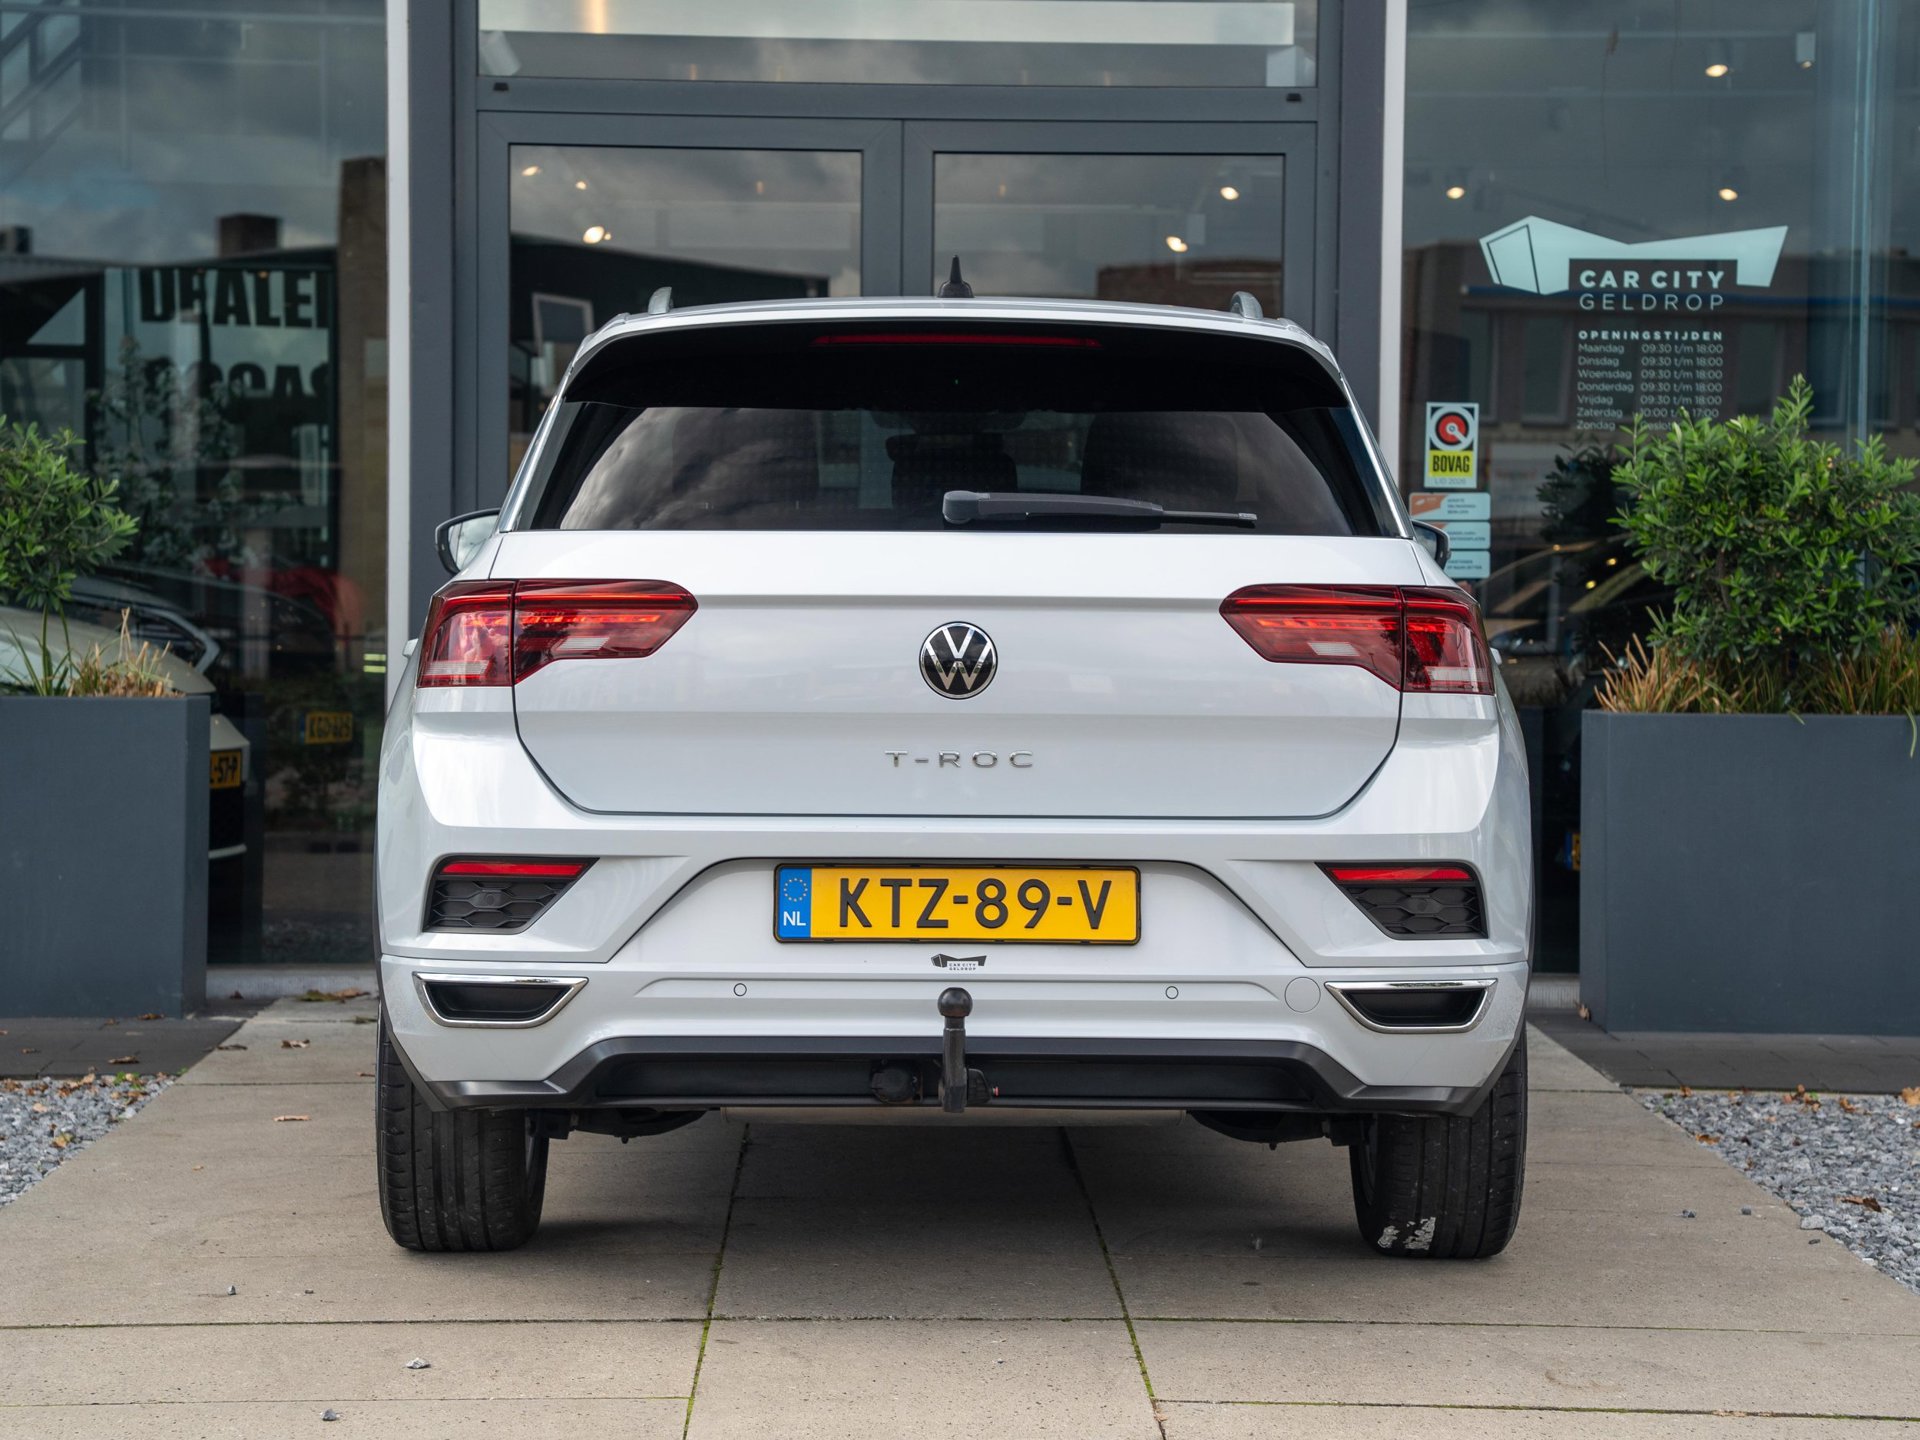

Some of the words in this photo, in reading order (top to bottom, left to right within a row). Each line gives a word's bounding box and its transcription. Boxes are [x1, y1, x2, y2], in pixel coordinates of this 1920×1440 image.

[1579, 270, 1639, 288] CAR
[1651, 270, 1724, 289] CITY
[1579, 293, 1724, 311] GELDROP
[1578, 330, 1722, 341] OPENINGSTIJDEN
[1578, 343, 1625, 354] Maandag
[1578, 356, 1619, 367] Dinsdag
[1577, 369, 1632, 380] Woensdag
[1577, 382, 1634, 393] Donderdag
[1577, 395, 1613, 406] Vrijdag
[1577, 407, 1623, 419] Zaterdag
[1577, 420, 1616, 432] Zondag
[1432, 455, 1470, 473] BOVAG
[885, 750, 1034, 768] T-ROC
[783, 912, 807, 927] NL
[839, 877, 1112, 930] KTZ-89-V
